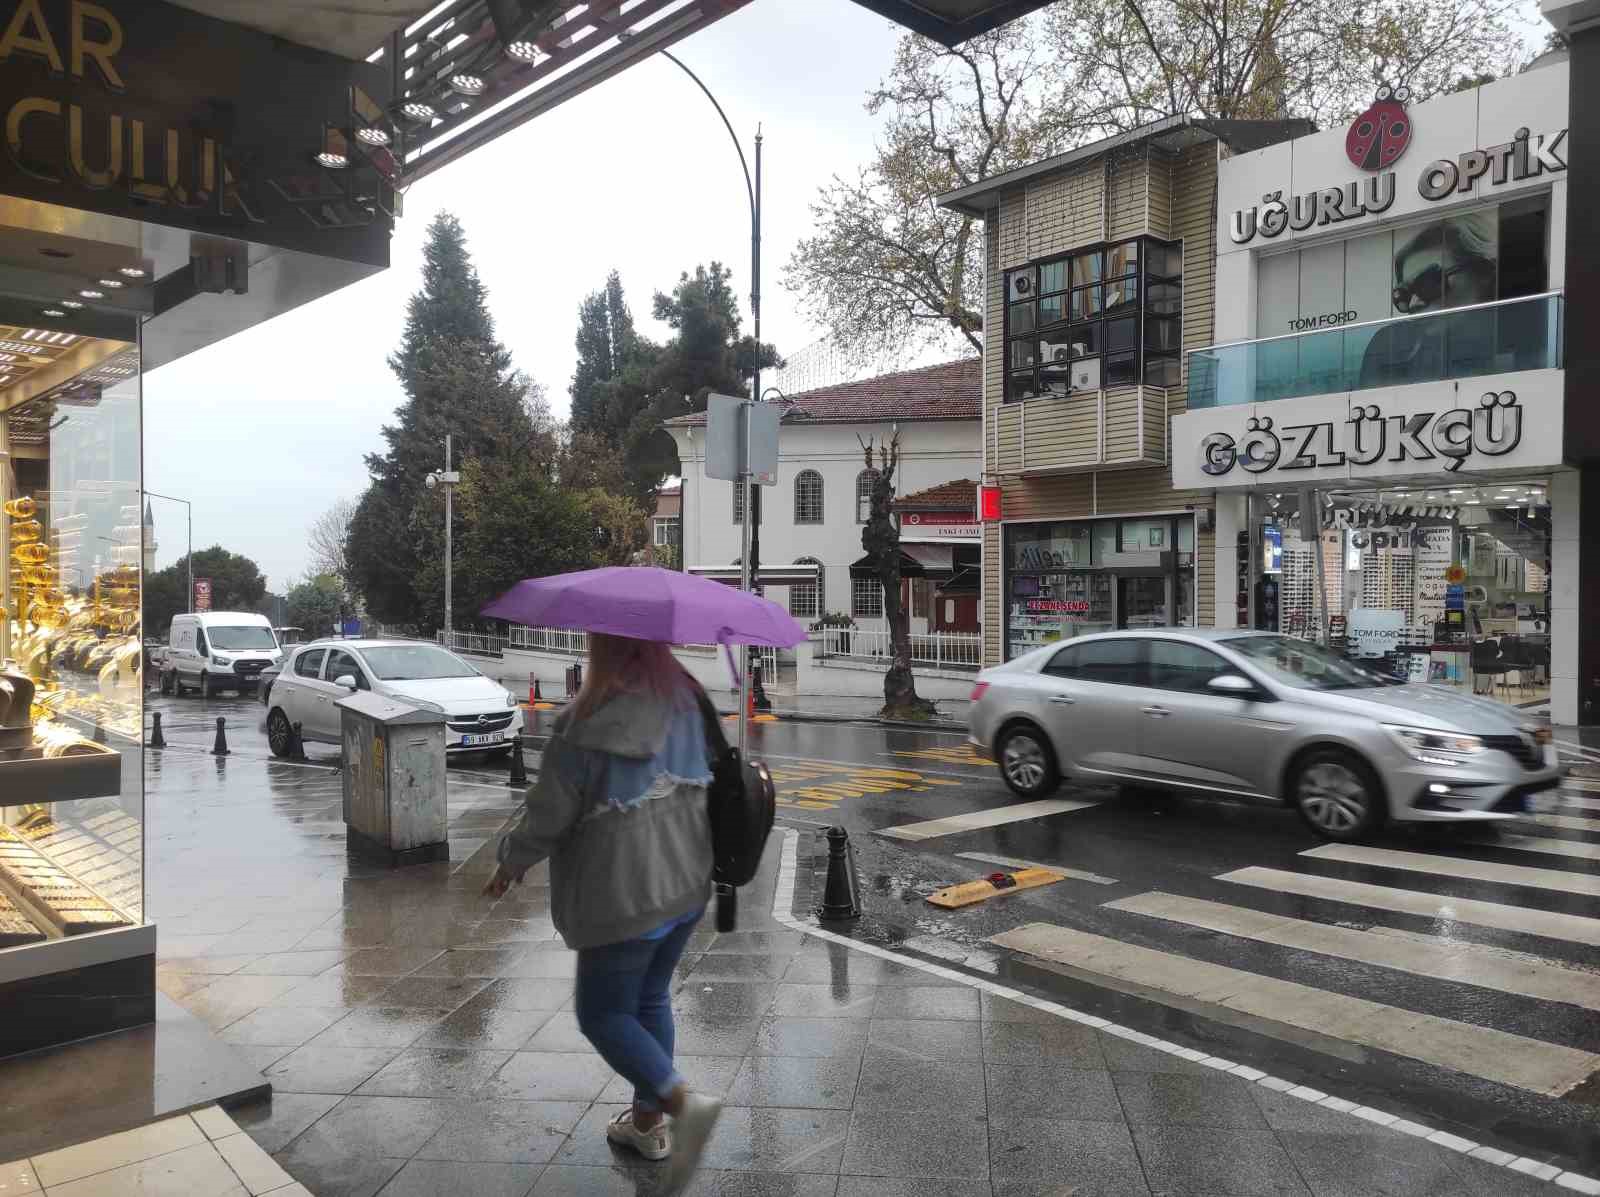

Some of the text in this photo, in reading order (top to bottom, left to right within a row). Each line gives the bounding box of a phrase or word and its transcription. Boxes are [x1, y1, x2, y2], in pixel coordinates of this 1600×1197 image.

[1230, 126, 1568, 244] UĞURLU OPTİK
[1288, 309, 1358, 331] TOM FORD
[1200, 390, 1523, 476] GÖZLÜKÇÜ
